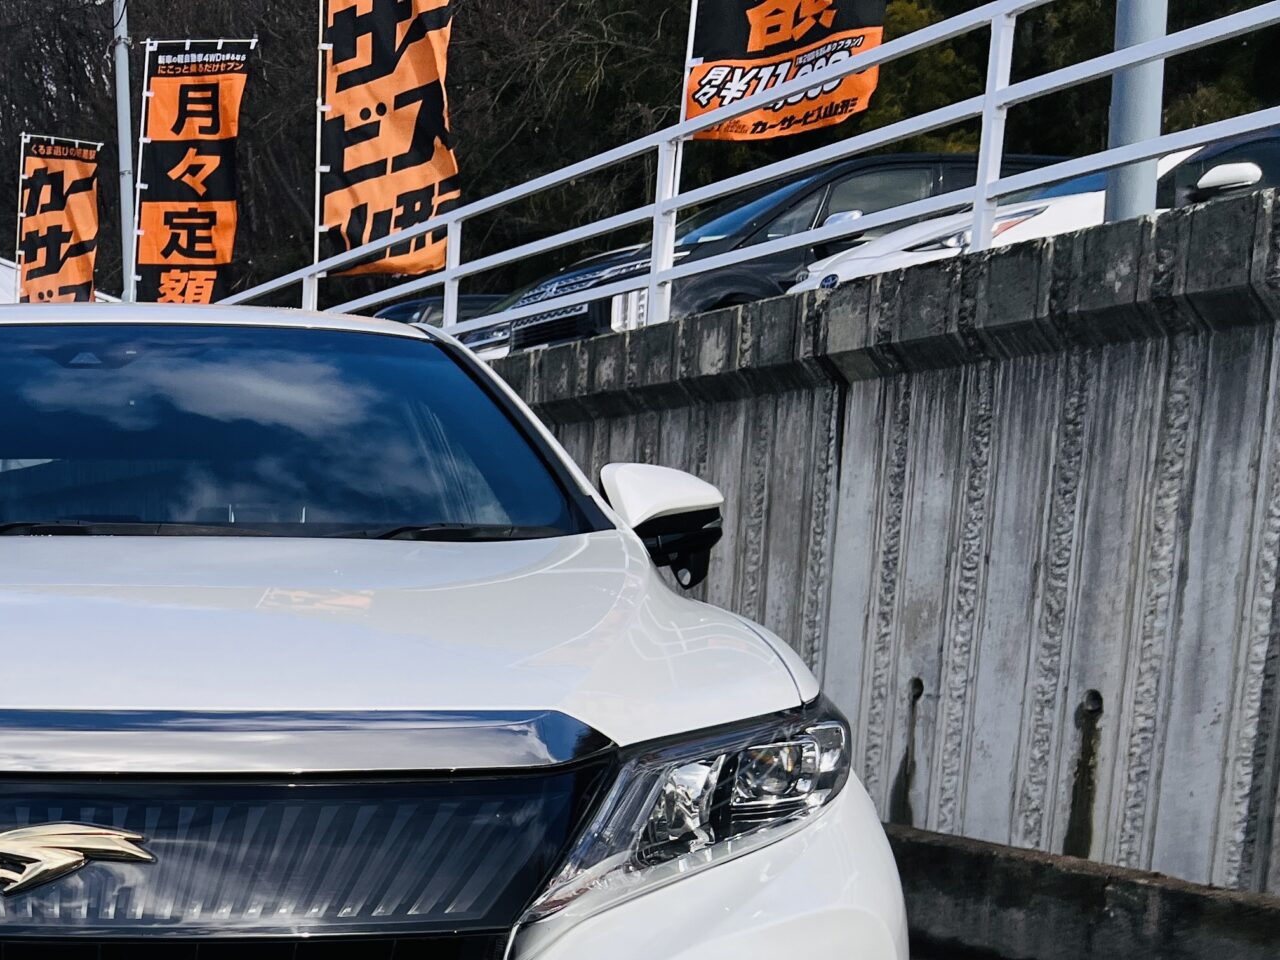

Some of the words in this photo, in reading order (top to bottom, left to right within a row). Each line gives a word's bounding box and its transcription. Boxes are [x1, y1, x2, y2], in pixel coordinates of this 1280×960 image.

[751, 97, 858, 135] カーサービス山形
